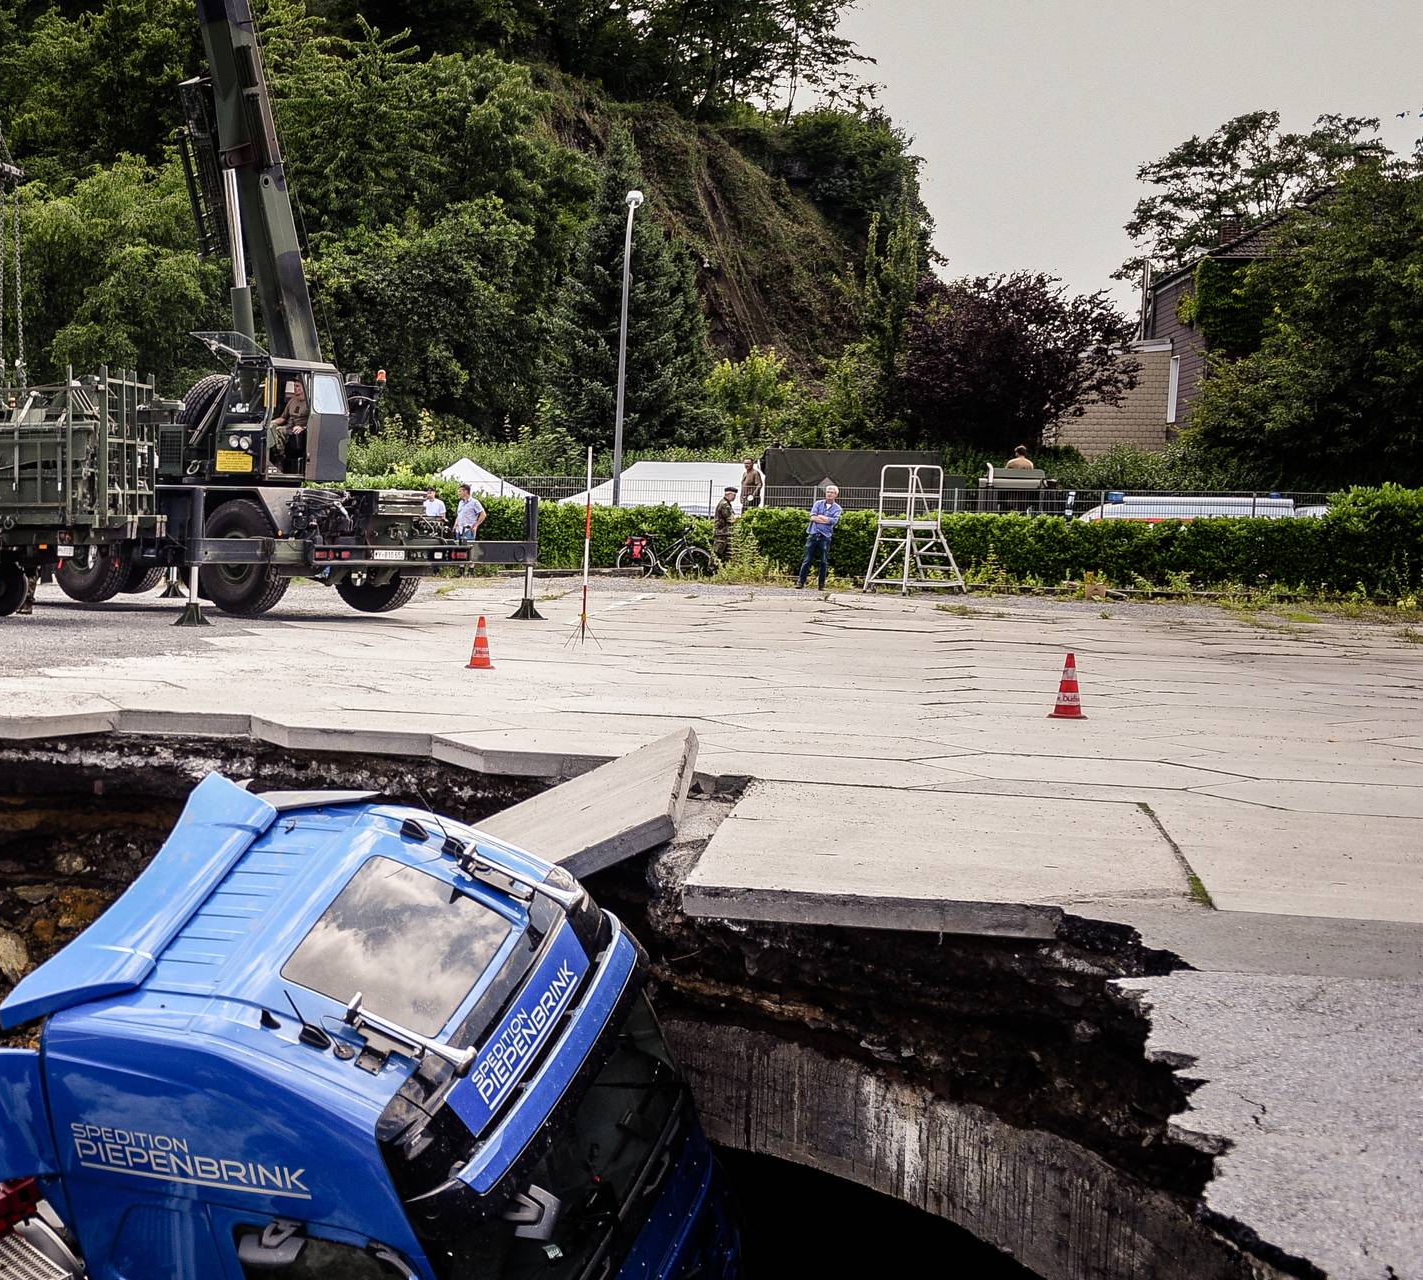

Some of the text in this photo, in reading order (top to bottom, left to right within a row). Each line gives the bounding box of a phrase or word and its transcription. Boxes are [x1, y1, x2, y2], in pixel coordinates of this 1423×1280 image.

[471, 1007, 529, 1086] SPEDITION
[476, 958, 575, 1105] PIEPENBRINK
[70, 1122, 189, 1154] SPEDITION
[74, 1138, 310, 1192] PIEPENBRINK
